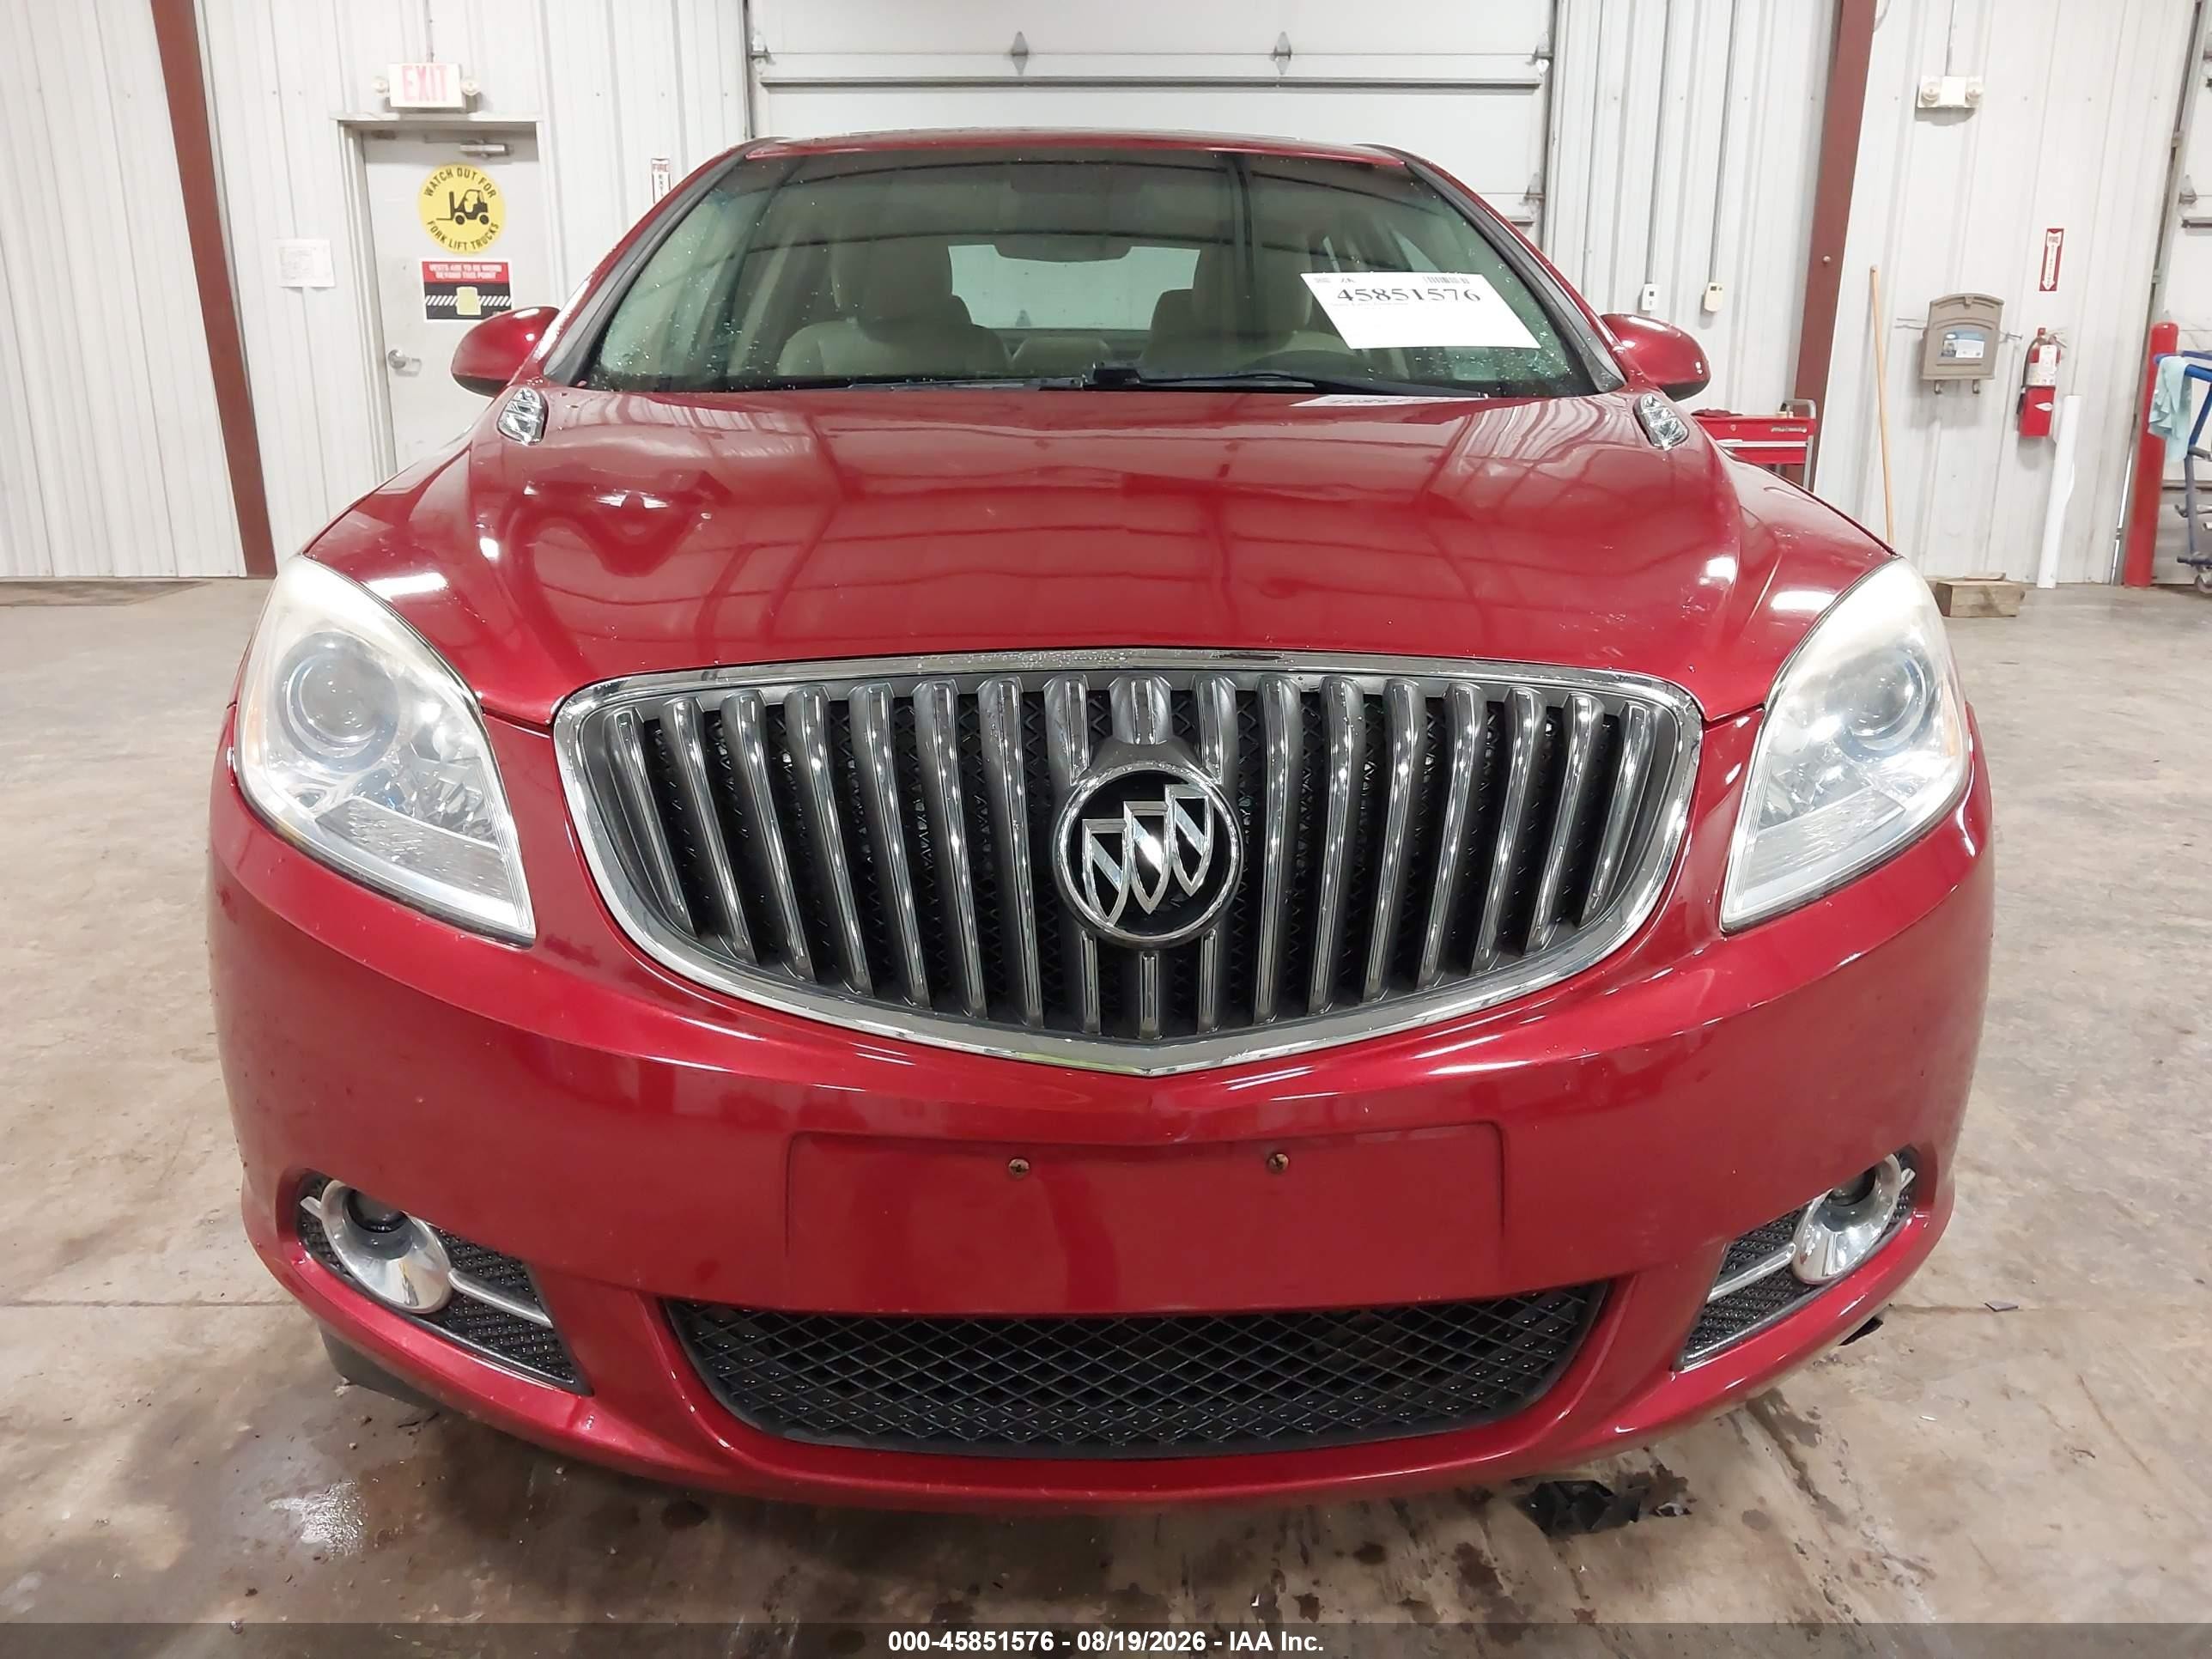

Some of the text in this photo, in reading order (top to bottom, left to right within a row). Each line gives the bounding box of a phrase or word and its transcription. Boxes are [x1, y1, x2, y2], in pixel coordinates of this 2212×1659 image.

[402, 65, 447, 101] EXIT
[424, 167, 496, 198] WATCH OUT FOR
[427, 221, 499, 251] FORK LIFT TRUCKS
[1336, 288, 1481, 302] 45851576
